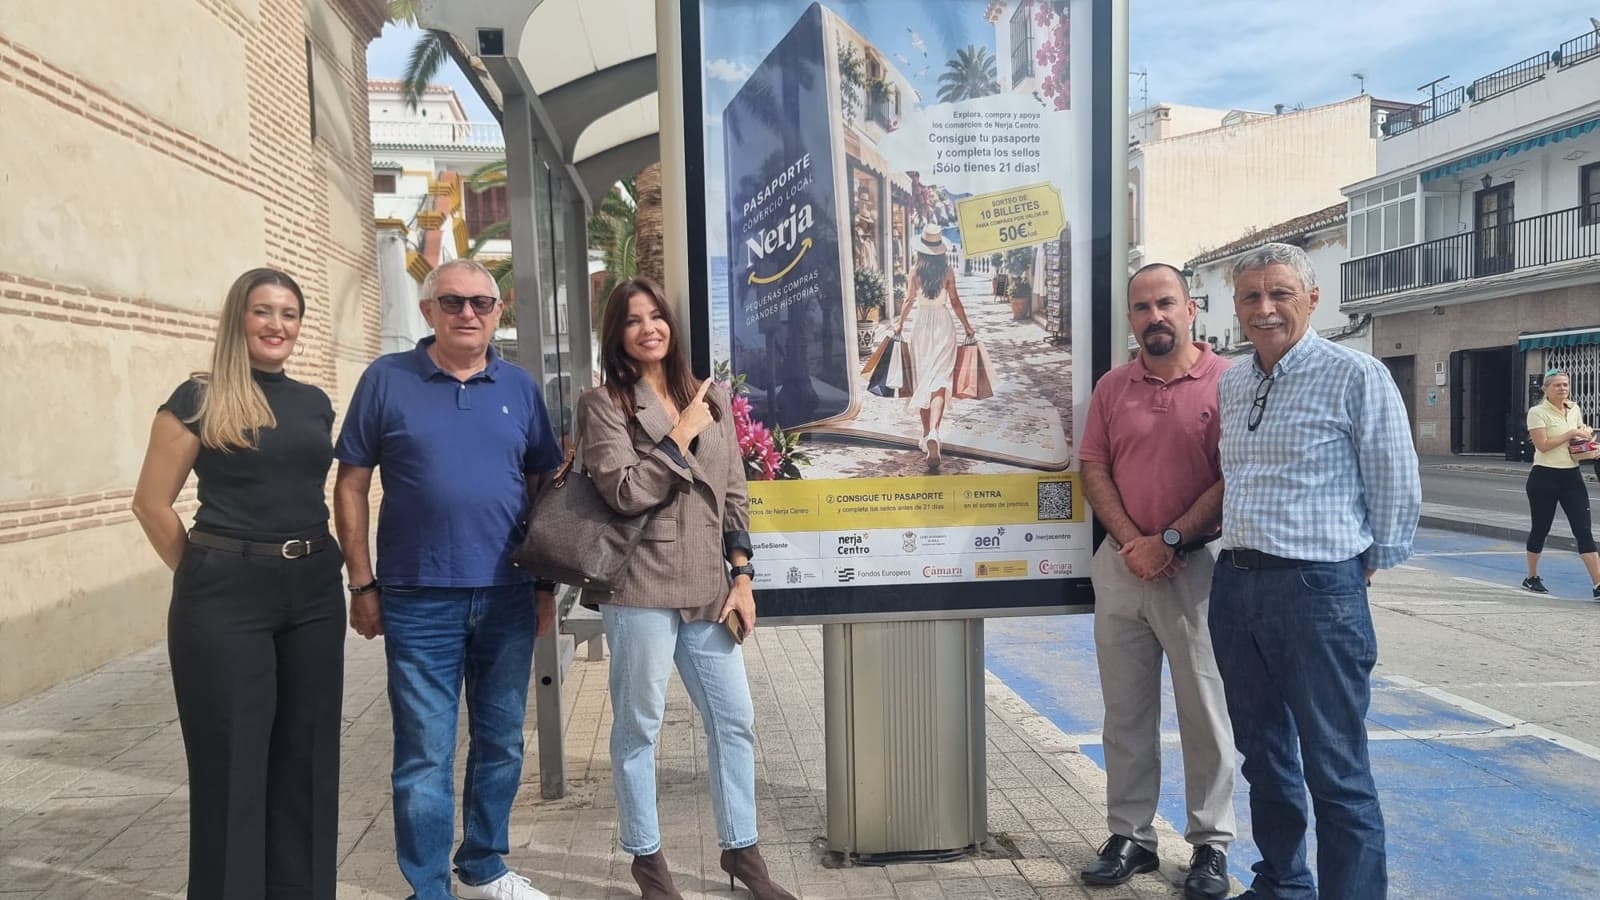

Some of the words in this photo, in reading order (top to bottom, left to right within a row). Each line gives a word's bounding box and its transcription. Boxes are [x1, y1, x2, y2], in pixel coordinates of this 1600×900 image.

[985, 112, 1011, 120] compra
[1019, 112, 1041, 120] apoya
[932, 121, 942, 129] los
[945, 121, 981, 129] comercios
[984, 121, 993, 129] de
[995, 121, 1013, 130] Nerja
[928, 133, 977, 145] Consigue
[980, 133, 989, 143] tu
[991, 133, 1040, 144] pasaporte
[937, 149, 943, 159] y
[945, 147, 991, 159] completa
[994, 147, 1008, 158] los
[1011, 147, 1040, 158] sellos
[932, 162, 961, 175] ¡Sólo
[964, 162, 996, 173] tienes
[999, 162, 1011, 173] 21
[1014, 162, 1040, 173] días!
[743, 153, 811, 217] PASAPORTE
[742, 195, 784, 233] COMERCIO
[785, 172, 813, 201] LOCAL
[991, 196, 1018, 207] SORTEO
[1018, 194, 1028, 202] DE
[980, 210, 992, 220] 10
[993, 200, 1040, 218] BILLETES
[745, 203, 815, 269] Nerja
[783, 269, 819, 294] COMPRAS
[746, 303, 779, 327] GRANDES
[780, 283, 820, 310] HISTORIAS
[836, 494, 880, 503] CONSIGUE
[881, 493, 893, 502] TU
[894, 491, 944, 502] PASAPORTE
[974, 490, 1002, 499] ENTRA
[842, 504, 869, 513] completa
[914, 502, 922, 511] de
[838, 533, 863, 547] nerja
[974, 534, 1001, 547] aen
[837, 544, 870, 555] Centro
[857, 569, 880, 578] Fondos
[881, 568, 912, 578] Europeos
